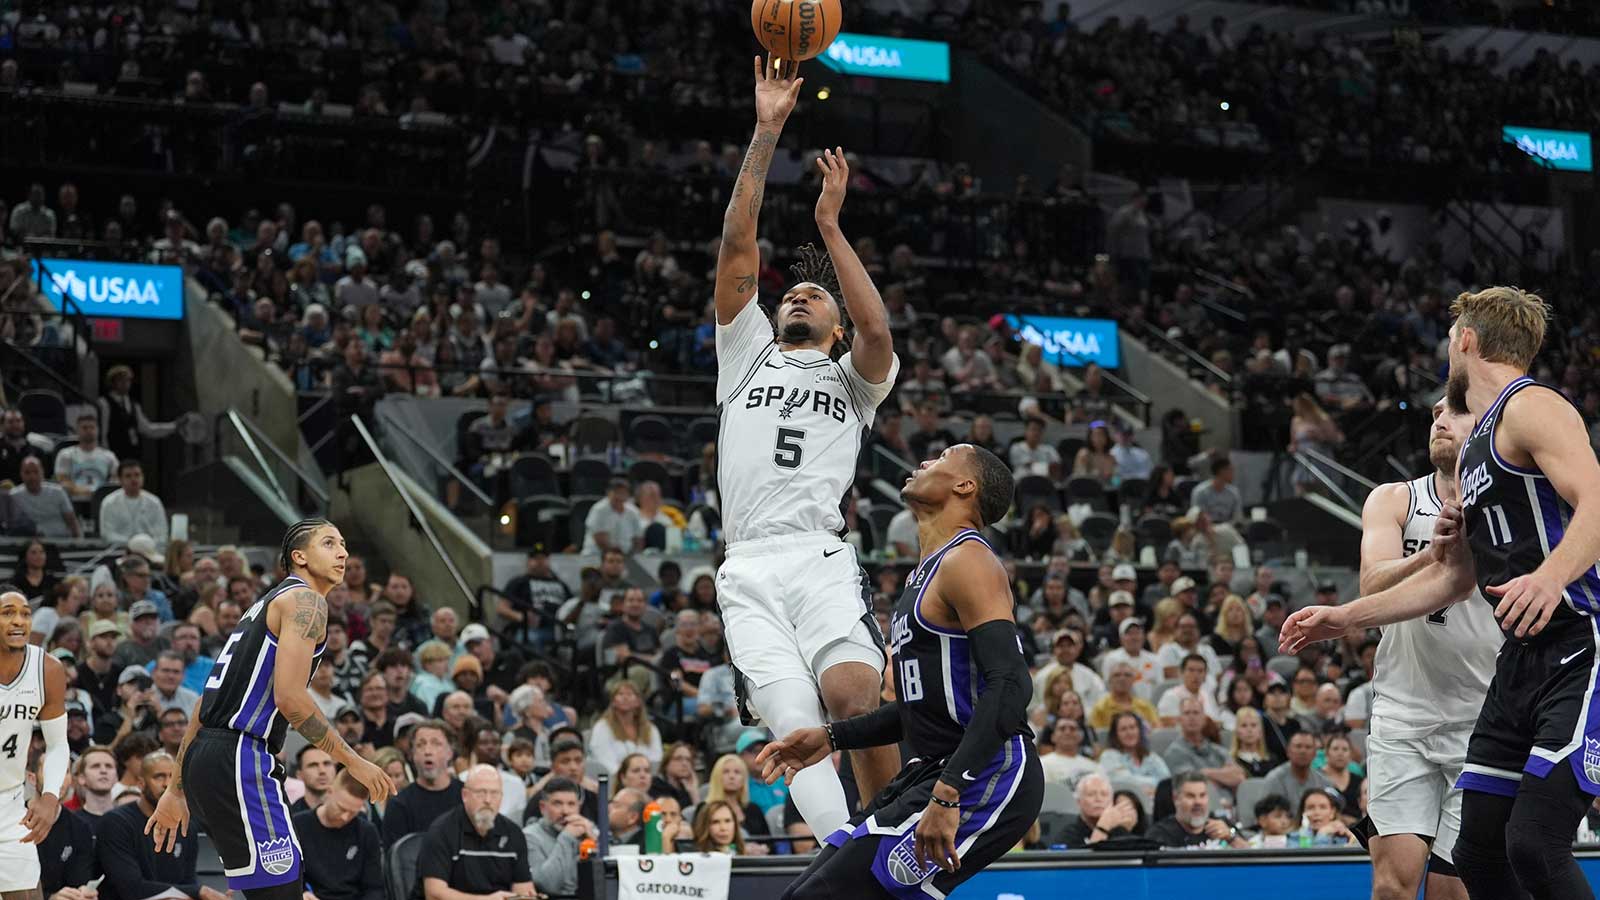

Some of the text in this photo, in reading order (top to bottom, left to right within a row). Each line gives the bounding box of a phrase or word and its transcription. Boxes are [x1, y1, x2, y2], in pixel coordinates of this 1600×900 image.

[798, 2, 816, 56] Wilson
[852, 45, 902, 68] USAA
[88, 275, 160, 305] USAA
[1043, 328, 1101, 355] USAA
[745, 386, 847, 423] SPURS
[773, 426, 806, 470] 5
[1461, 461, 1493, 508] ings
[1482, 504, 1513, 546] 11
[899, 658, 924, 702] 18
[2, 733, 18, 759] 4
[261, 849, 292, 864] KINGS
[894, 845, 928, 879] KINGS
[636, 883, 704, 898] GATORADE
